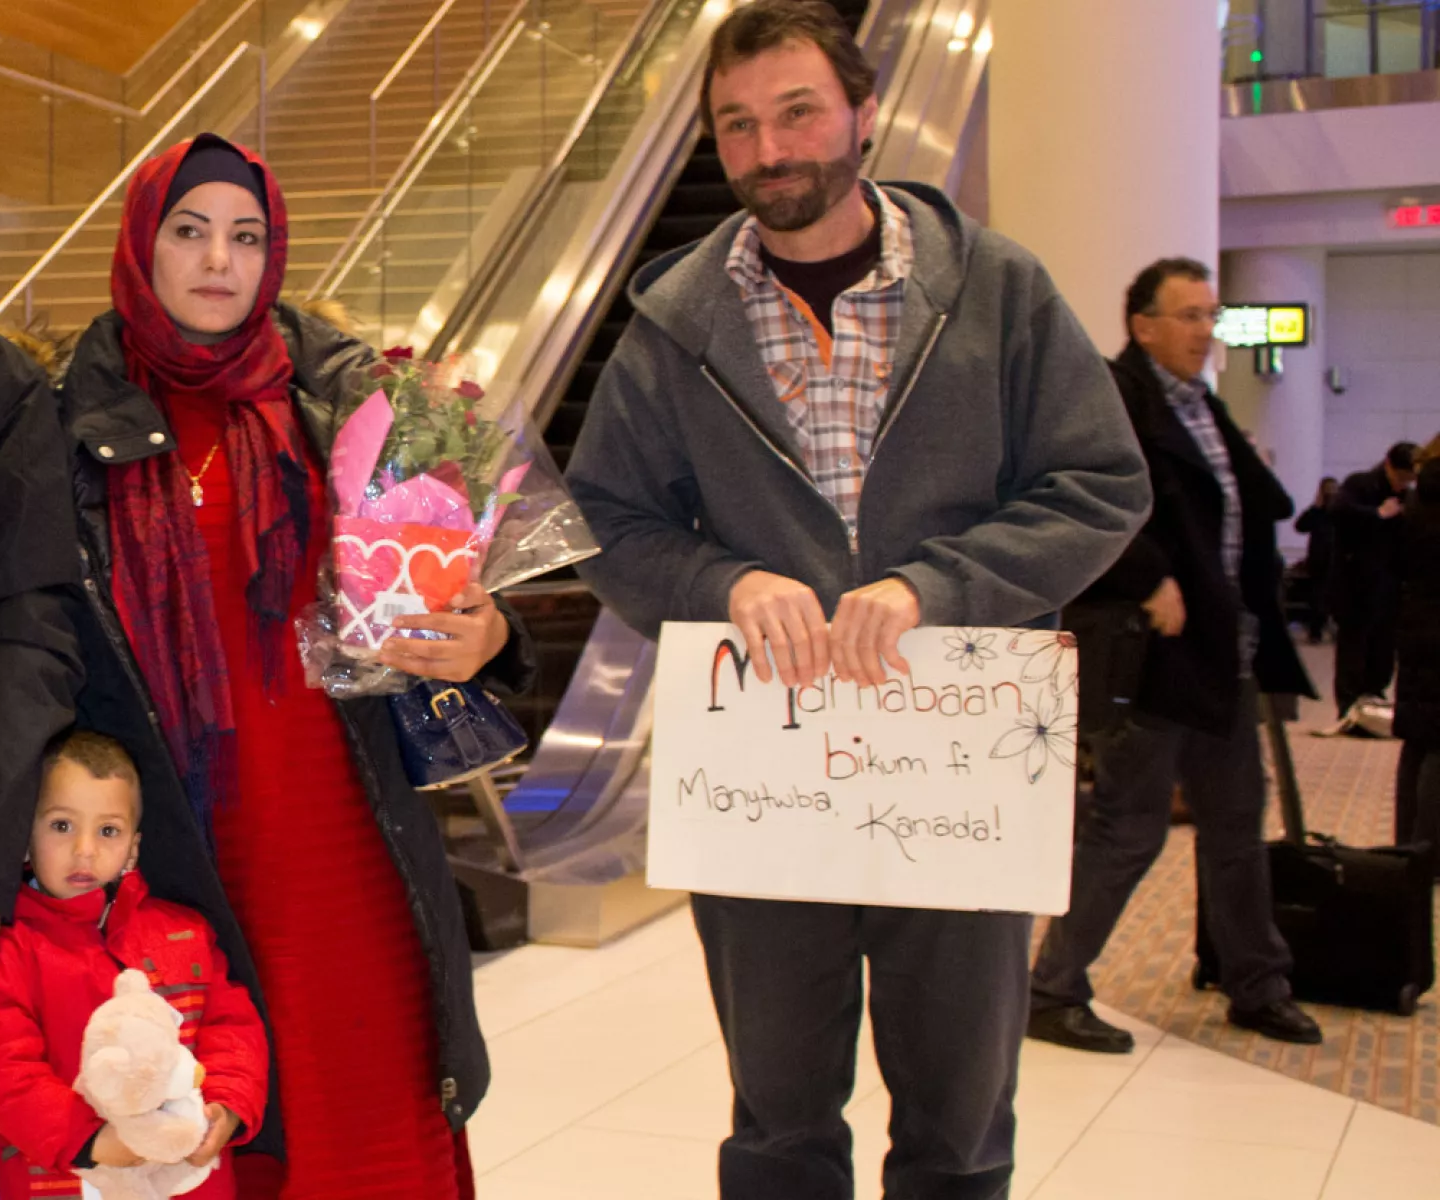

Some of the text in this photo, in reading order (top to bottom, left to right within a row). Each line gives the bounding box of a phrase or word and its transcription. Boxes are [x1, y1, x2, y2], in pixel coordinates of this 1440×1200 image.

[824, 731, 972, 780] bikum fi
[855, 803, 1002, 862] Kanada!
